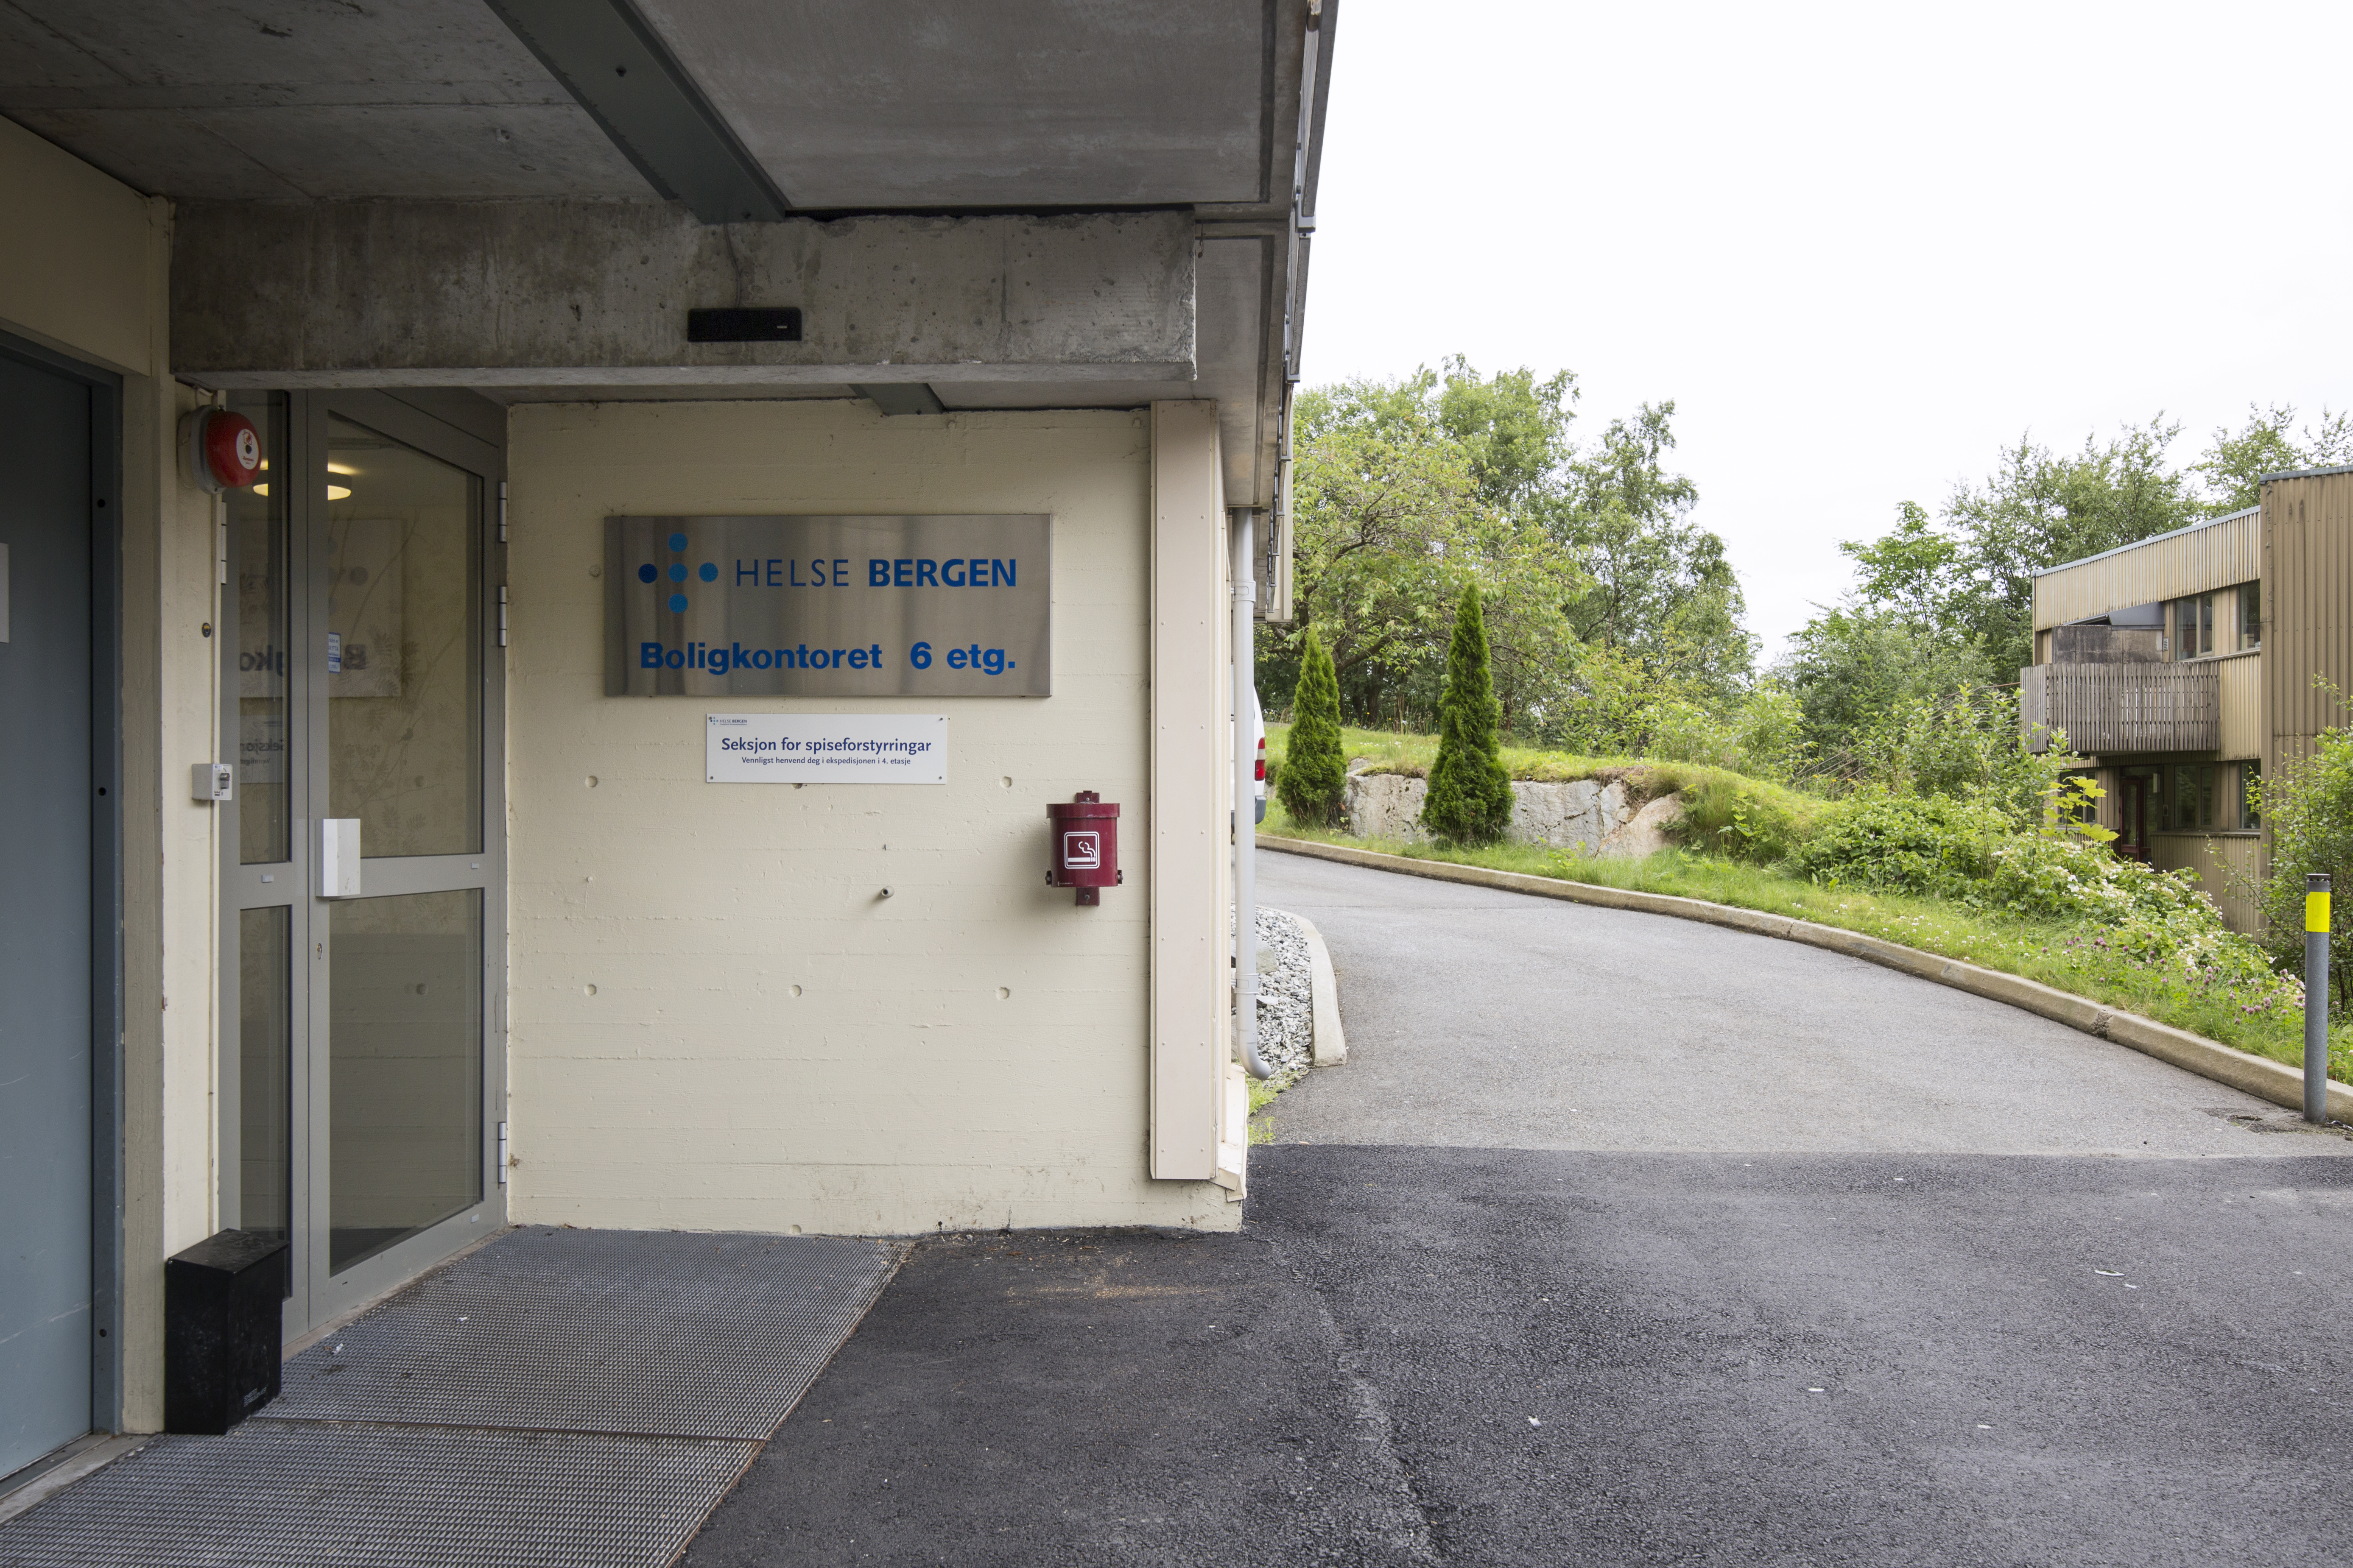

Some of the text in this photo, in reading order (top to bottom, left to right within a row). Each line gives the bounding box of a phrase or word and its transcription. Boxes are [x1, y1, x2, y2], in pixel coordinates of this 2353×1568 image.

[737, 559, 1016, 587] HELSE BERGEN
[641, 642, 1016, 676] Boligkontoret 6 etg.
[721, 737, 931, 755] Seksjon for spiseforstyrringar
[741, 756, 774, 765] Vennligst
[807, 756, 820, 765] deg
[826, 757, 875, 765] ekspedisjonen
[890, 757, 911, 766] etasje
